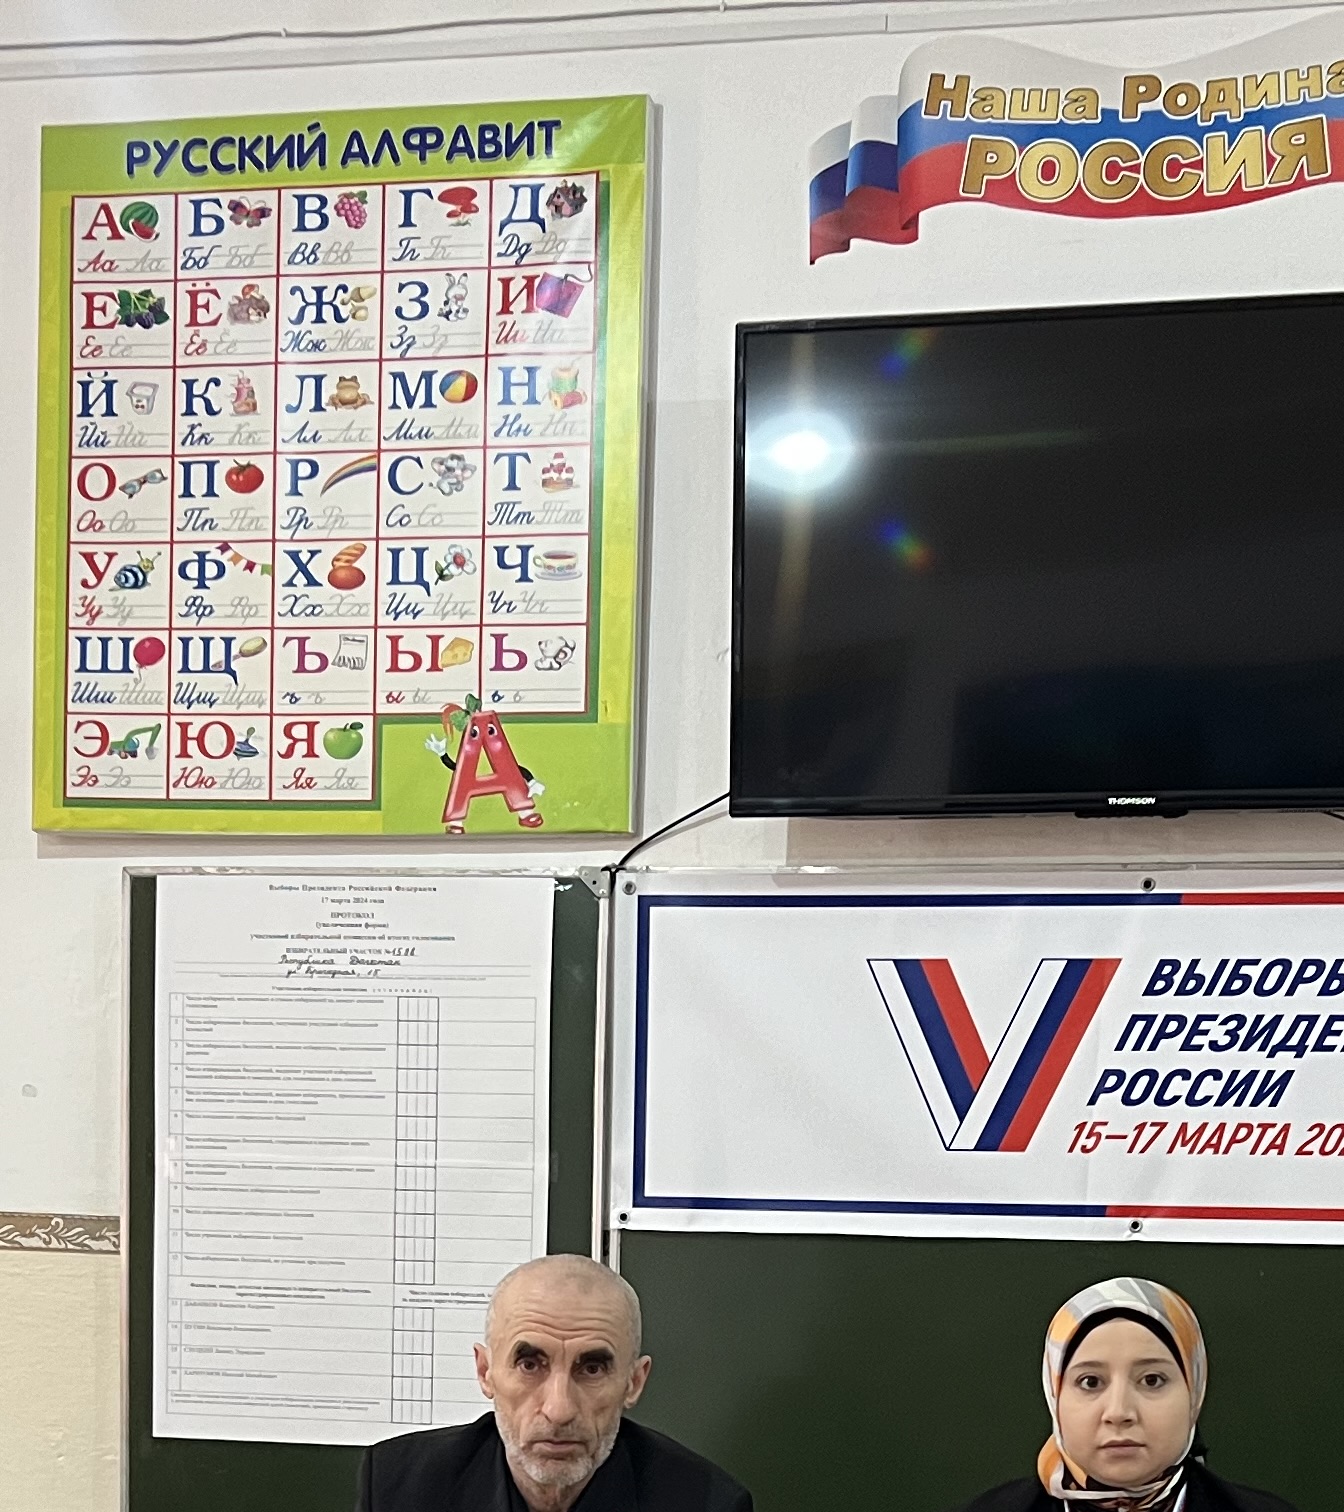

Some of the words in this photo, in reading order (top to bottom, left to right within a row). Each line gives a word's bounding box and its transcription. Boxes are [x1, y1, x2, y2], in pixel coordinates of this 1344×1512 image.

[923, 71, 1101, 123] Наша
[126, 123, 328, 177] РУССКИЙ
[340, 119, 561, 169] АЛФАВИТ
[961, 116, 1329, 199] РОССИЯ
[81, 203, 126, 241] А
[187, 197, 225, 237] Б
[291, 194, 329, 232] В
[398, 188, 434, 228] Г
[498, 183, 550, 239] Д
[80, 289, 121, 330] Е
[184, 283, 223, 328] Ё
[288, 284, 353, 325] Ж
[395, 281, 429, 321] З
[496, 274, 540, 316] И
[77, 371, 119, 418] Й
[180, 377, 222, 417] К
[285, 374, 328, 413] Л
[388, 370, 438, 410] М
[497, 366, 541, 406] Н
[77, 462, 116, 501] О
[178, 460, 220, 499] П
[285, 458, 319, 497] Р
[388, 455, 424, 496] С
[493, 452, 531, 491] Т
[78, 551, 120, 592] У
[178, 550, 226, 590] Ф
[282, 549, 323, 588] Х
[386, 546, 431, 599] Ц
[493, 544, 535, 583] Ч
[74, 636, 135, 674] Ш
[175, 636, 242, 688] Щ
[282, 636, 329, 674] Ъ
[385, 634, 448, 673] Ы
[489, 633, 528, 671] Ь
[73, 720, 113, 758] Э
[175, 721, 239, 761] Ю
[277, 721, 320, 759] Я
[1086, 1068, 1295, 1107] РОССИИ
[1166, 1122, 1291, 1156] МАРТА
